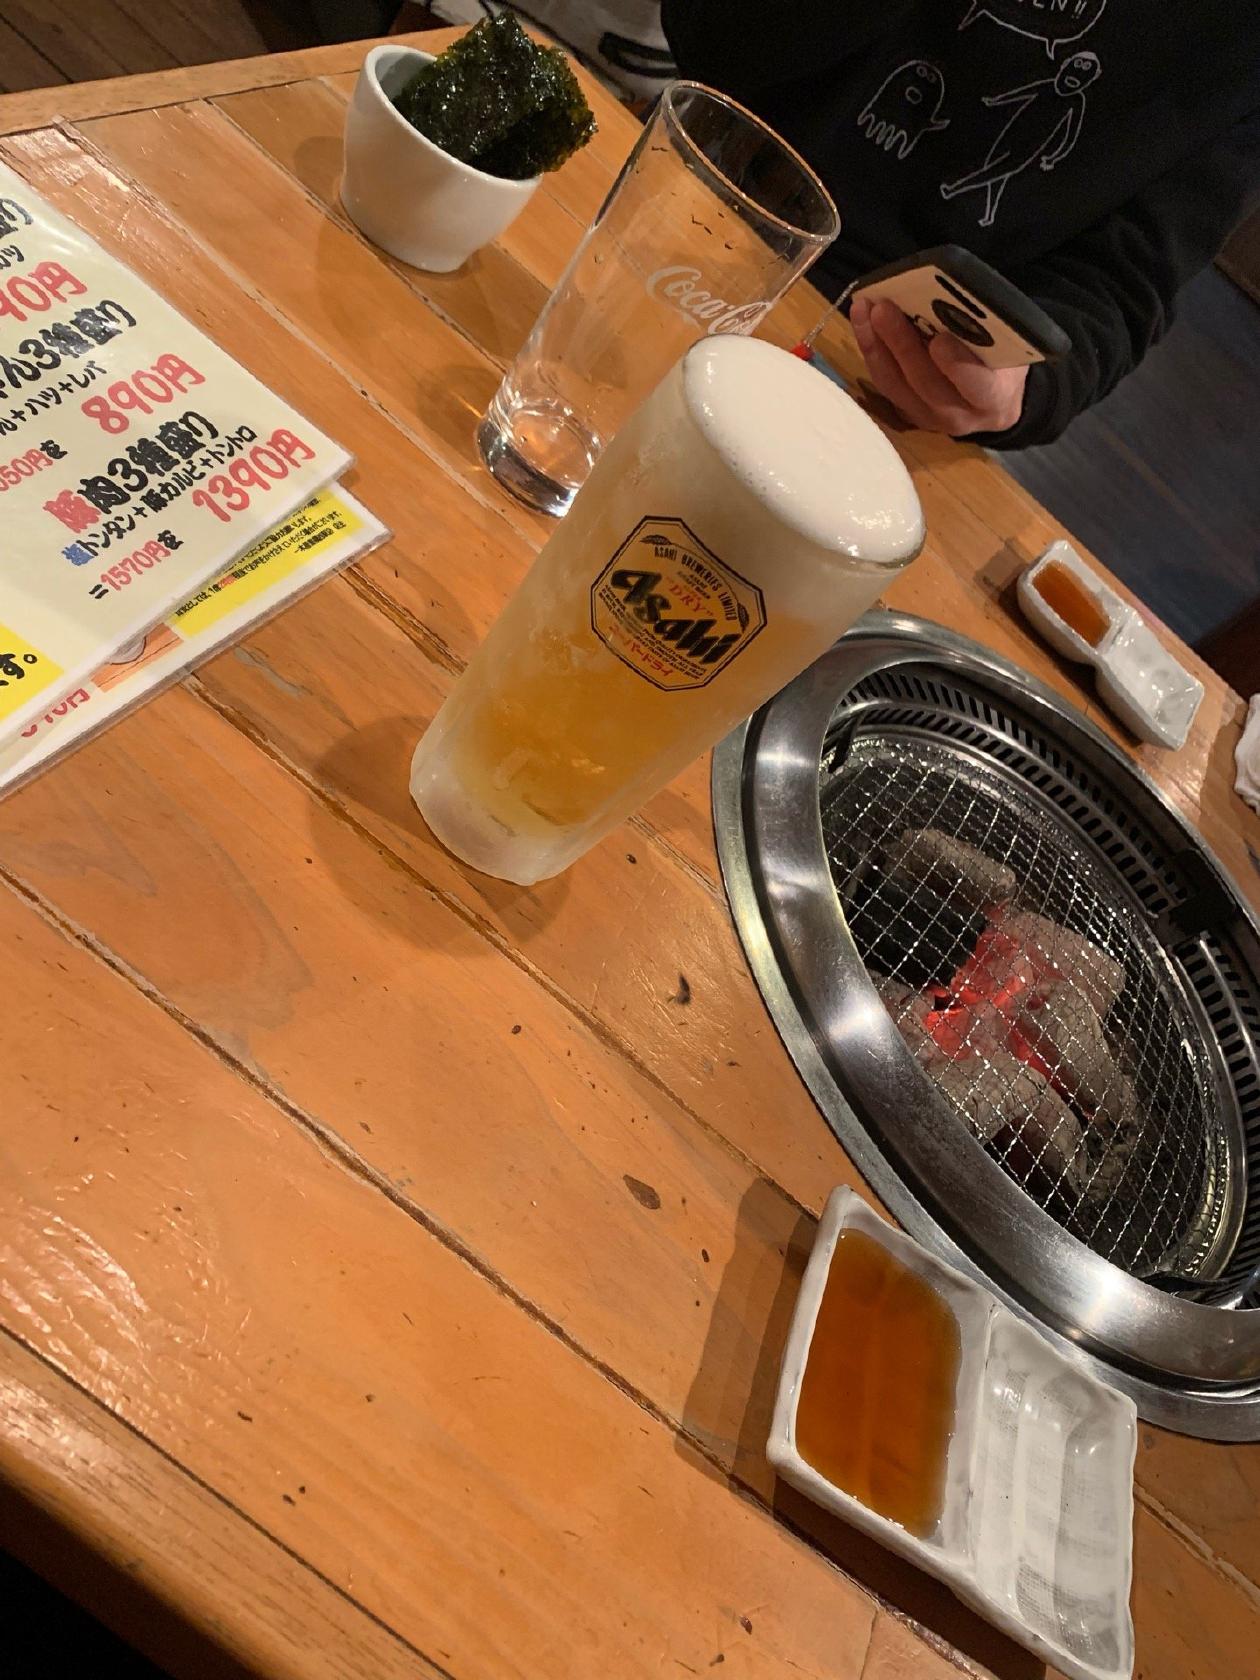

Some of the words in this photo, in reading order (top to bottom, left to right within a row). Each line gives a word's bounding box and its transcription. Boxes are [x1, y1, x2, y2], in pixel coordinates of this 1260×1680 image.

[81, 354, 206, 434] 890円
[192, 429, 316, 522] 1390円
[611, 569, 742, 664] Asahi
[654, 547, 678, 561] ASAHI
[681, 553, 723, 592] BREWERIES
[718, 592, 738, 621] LIMITED
